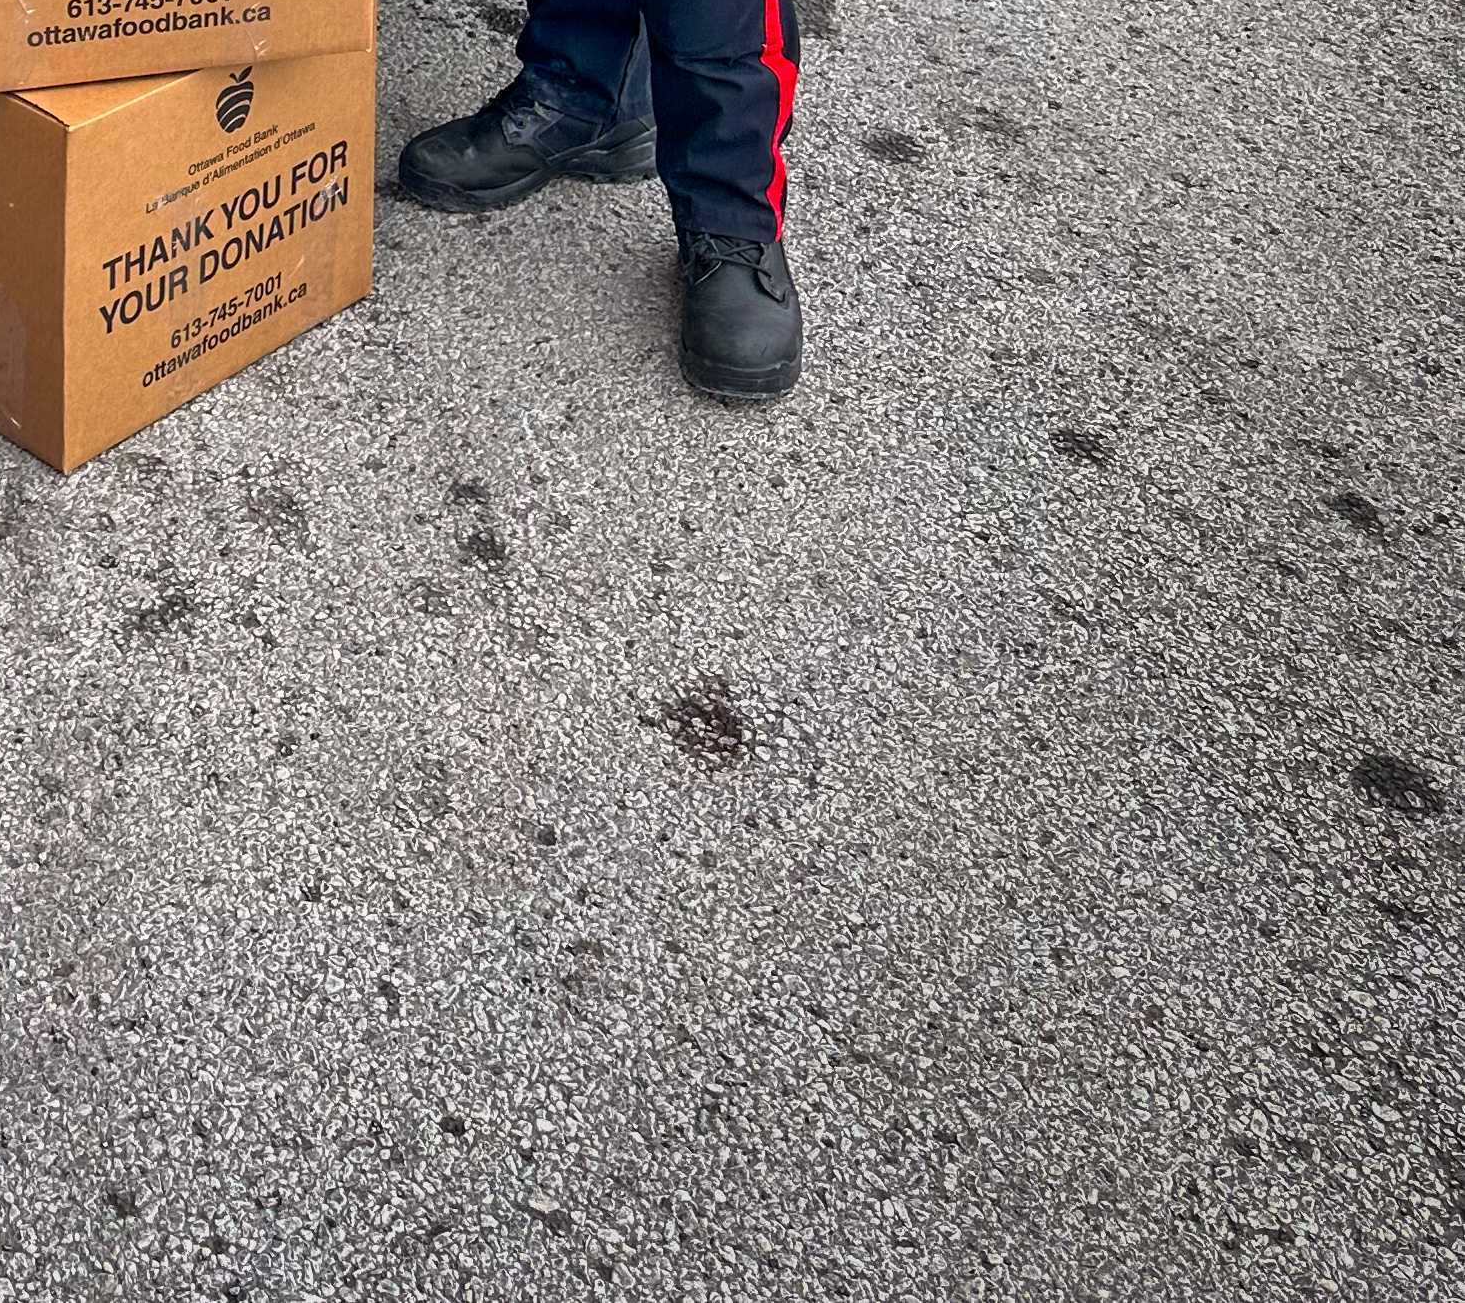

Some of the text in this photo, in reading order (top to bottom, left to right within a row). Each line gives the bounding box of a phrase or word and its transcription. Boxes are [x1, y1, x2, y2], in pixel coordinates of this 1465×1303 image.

[27, 2, 271, 48] ottawafoodbank.ca
[146, 200, 159, 214] La
[202, 144, 272, 186] d'Alimentation
[273, 122, 316, 150] d'Ottawa
[188, 124, 279, 176] Ottawa Food Bank
[99, 177, 349, 335] YOUR DONATION
[102, 139, 348, 291] THANK YOU FOR
[142, 282, 307, 388] ottawafoodbank.ca
[170, 271, 283, 349] 613-745-7001
